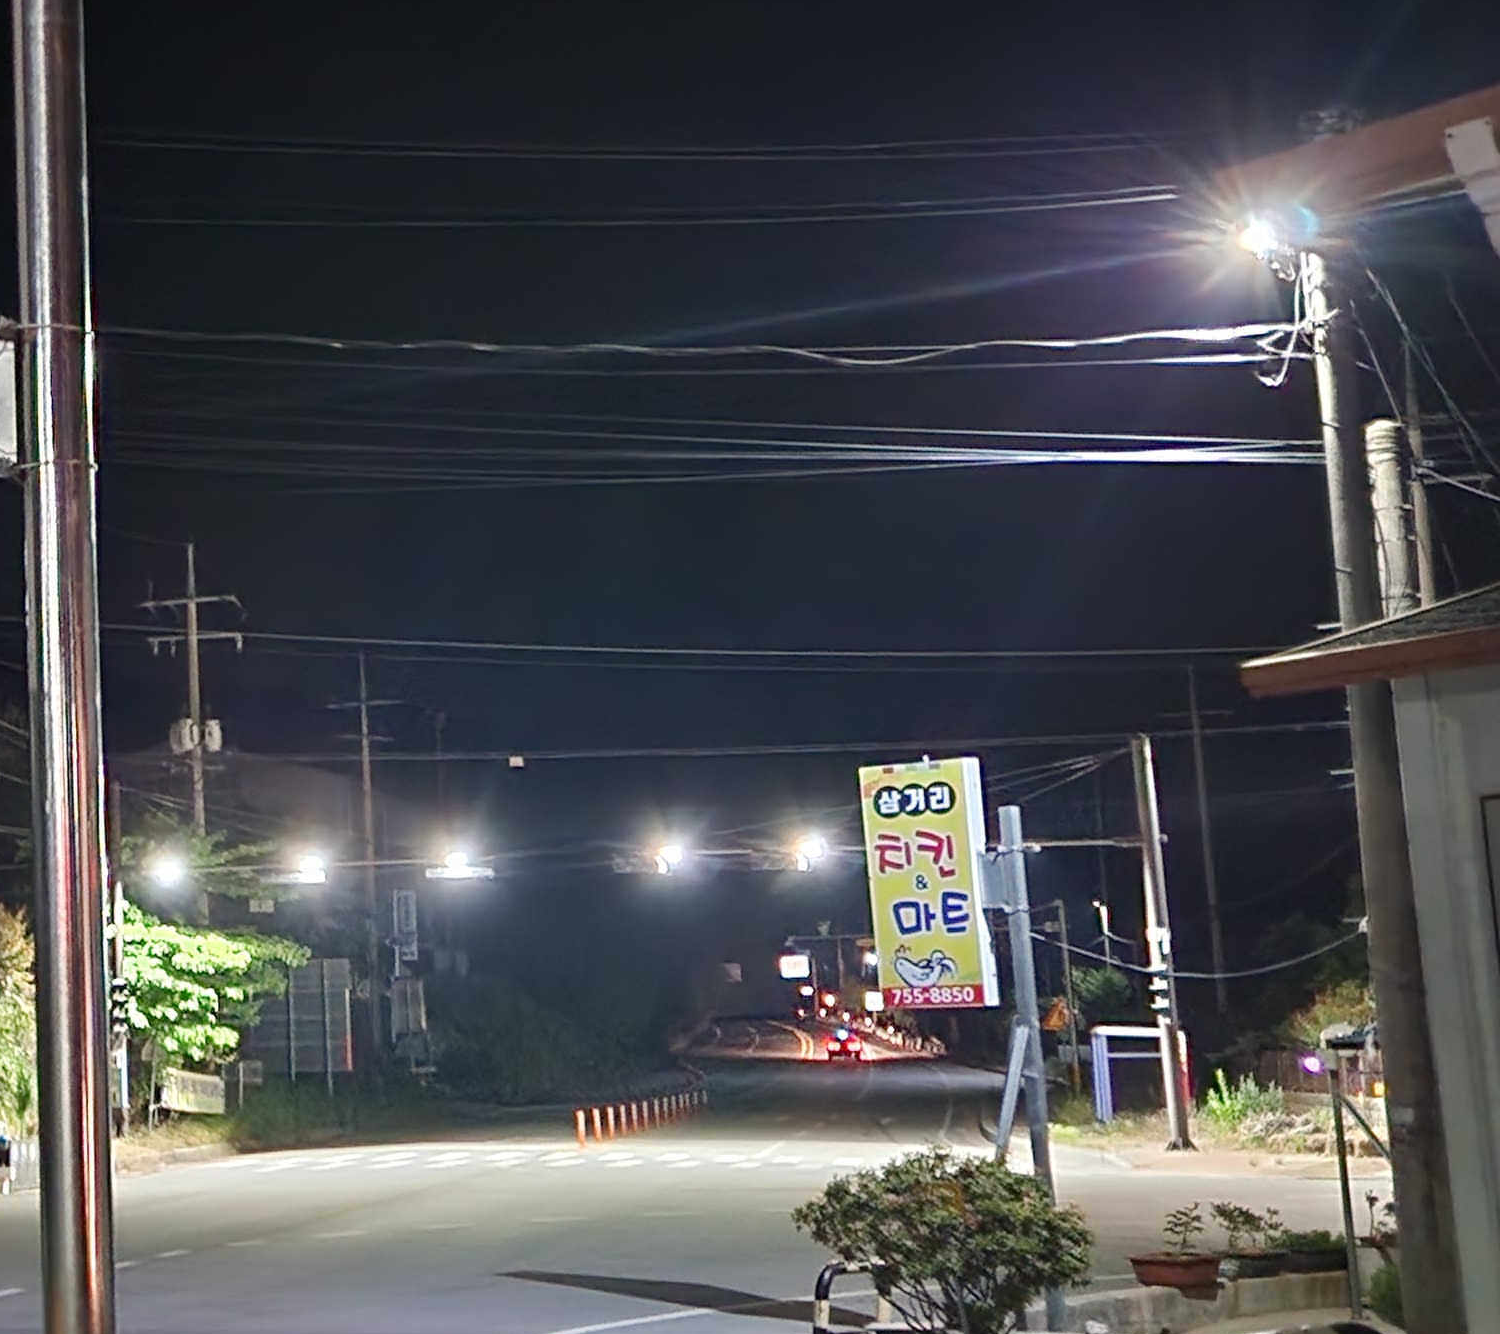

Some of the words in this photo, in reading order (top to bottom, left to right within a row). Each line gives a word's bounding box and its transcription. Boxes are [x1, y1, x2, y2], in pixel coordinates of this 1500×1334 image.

[877, 785, 951, 815] 삼거리
[874, 830, 956, 878] 치킨
[915, 874, 929, 890] &
[893, 891, 970, 934] 마트
[891, 987, 975, 1005] 755-8850
